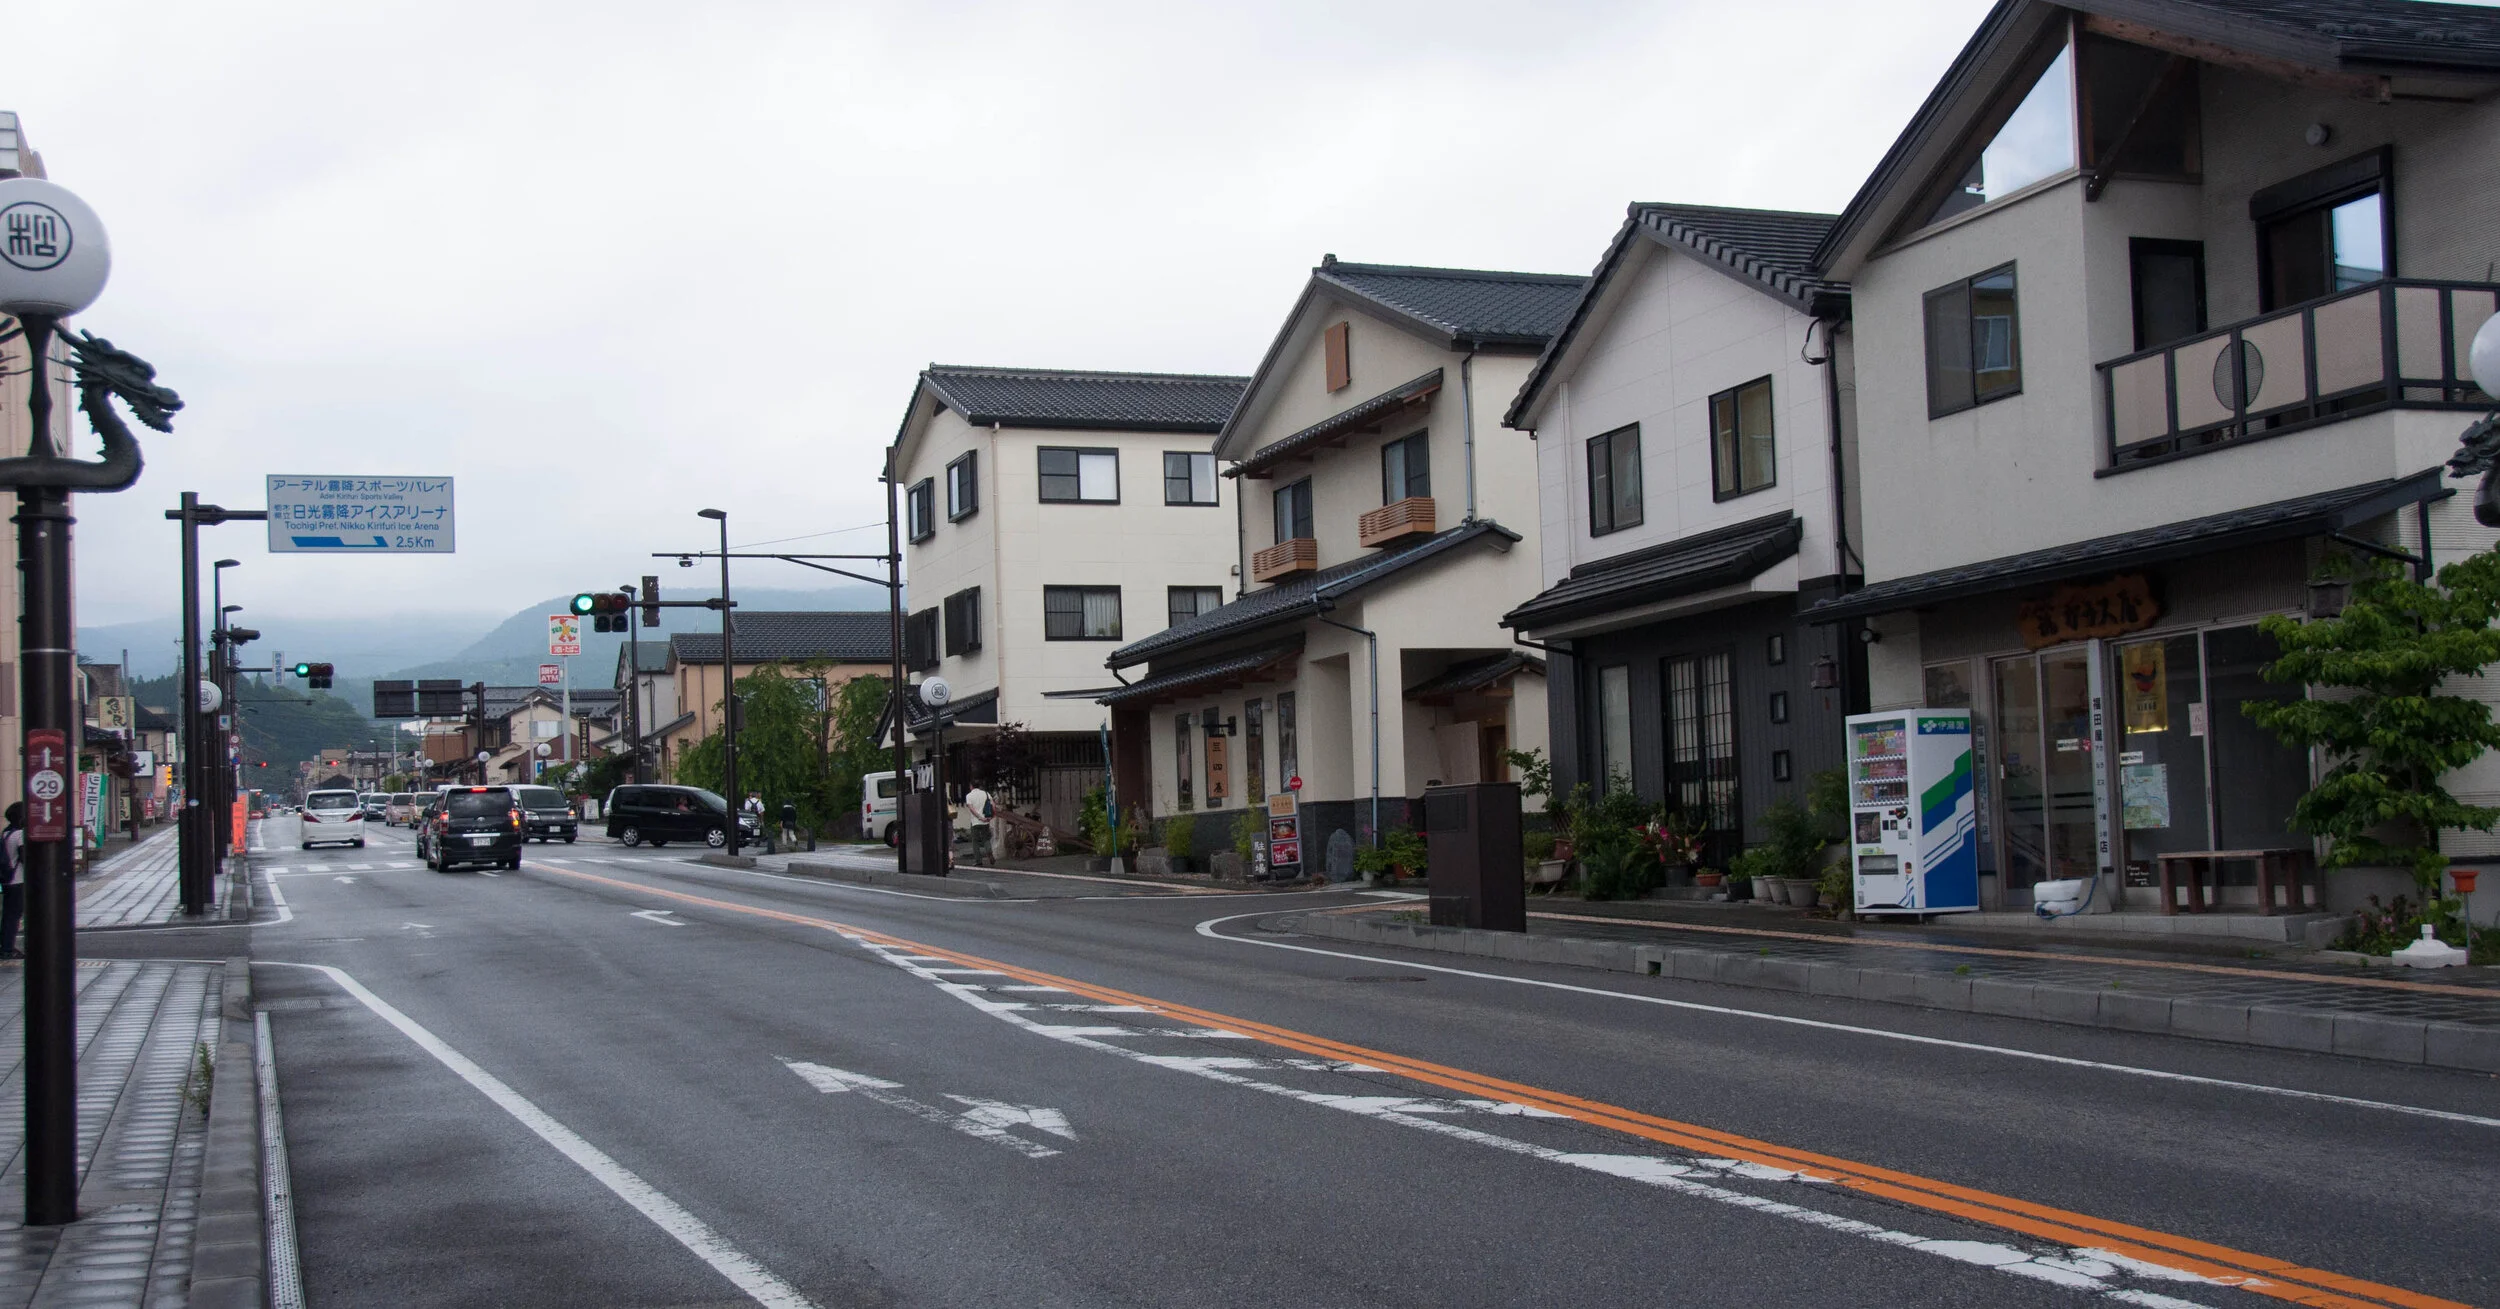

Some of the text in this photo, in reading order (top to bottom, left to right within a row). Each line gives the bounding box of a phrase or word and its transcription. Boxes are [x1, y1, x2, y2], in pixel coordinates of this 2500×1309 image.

[285, 521, 440, 531] Tochigi Pref. Nikko Kirifuri Ice Arena
[2093, 697, 2103, 741] 福田屋
[36, 780, 59, 794] 29
[1254, 841, 1266, 874] 駐車場
